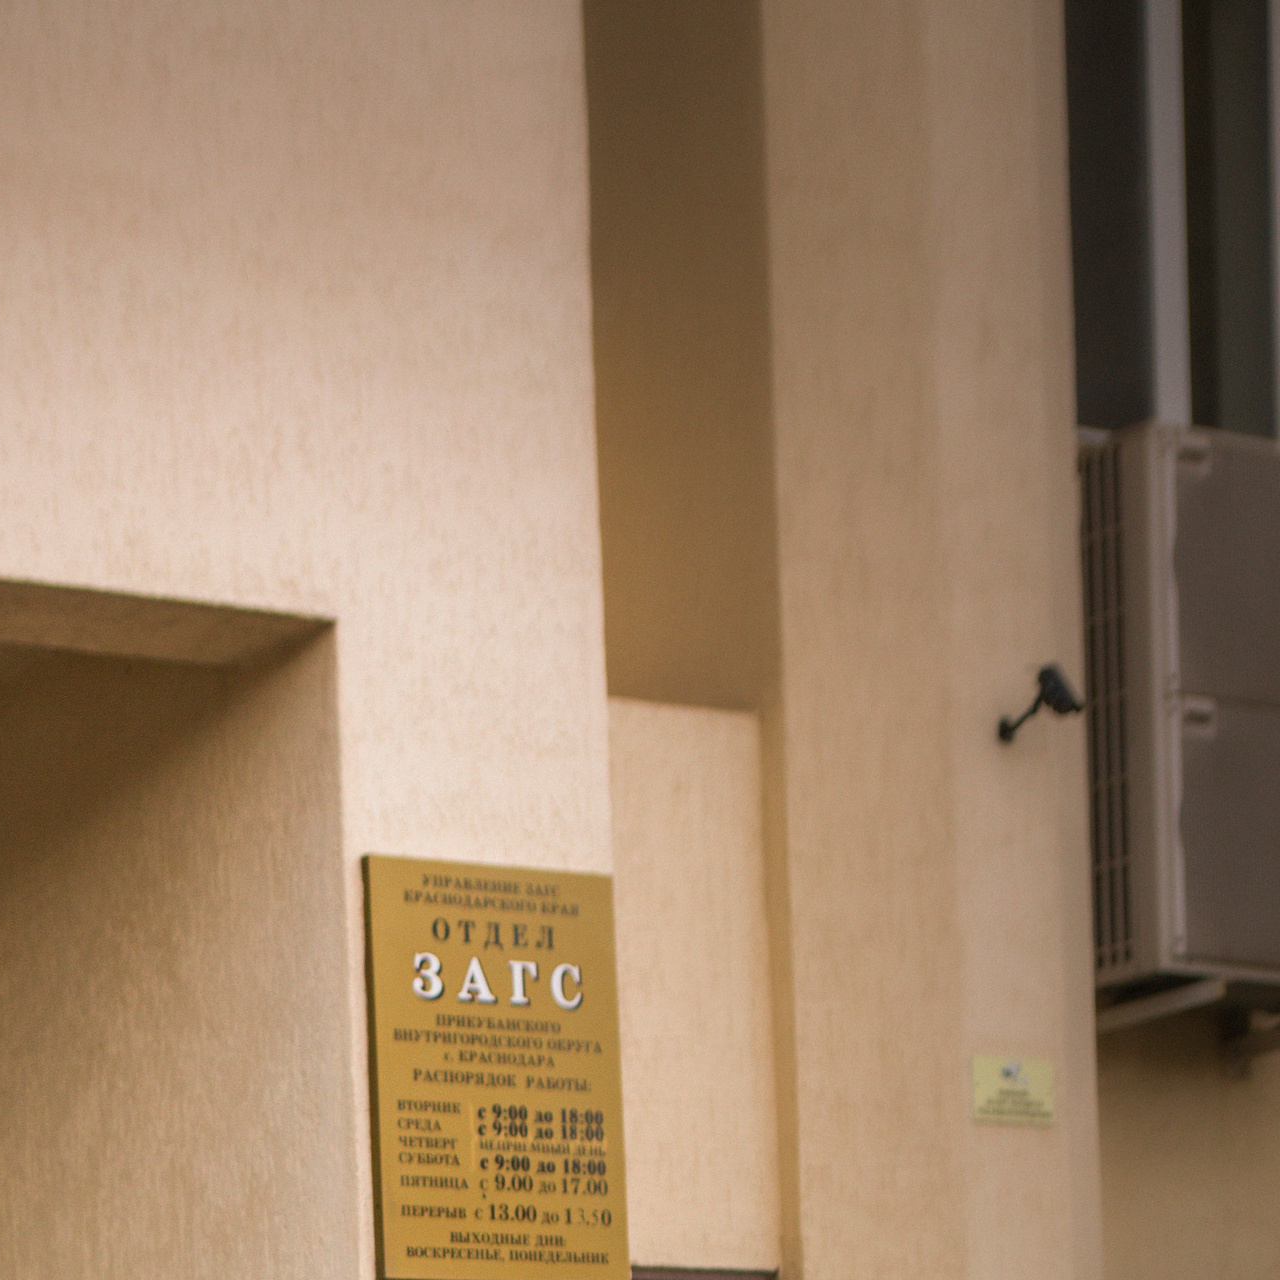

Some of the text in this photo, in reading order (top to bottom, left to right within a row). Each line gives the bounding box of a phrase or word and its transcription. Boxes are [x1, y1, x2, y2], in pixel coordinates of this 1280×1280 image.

[423, 873, 560, 898] УПРАВЛЕНИЕ ЗАГС
[404, 888, 579, 916] КРАСНОДАРСКОГО КРАЯ
[432, 917, 554, 950] ОТДЕЛ
[412, 952, 583, 1010] ЗАГС
[436, 1014, 561, 1034] ПРИКУБАНСКОГО
[393, 1028, 602, 1054] ВНУТРИГОРОДСКОГО ОКРУГА
[459, 1050, 555, 1068] КРАСНОДАРА
[413, 1068, 516, 1087] РАСПОРЯДОК
[397, 1100, 604, 1125] ВТОРНИК с 9:00 до 18:00
[397, 1117, 604, 1142] СРЕДА с 9:00 до 18:00
[399, 1136, 458, 1150] ЧЕТВЕРГ
[398, 1152, 606, 1176] СУББОТА с 9:00 до 18:00
[400, 1175, 468, 1190] ПЯТНИЦА
[494, 1173, 533, 1192] 9.00
[539, 1181, 556, 1194] до
[562, 1177, 608, 1196] 17.00
[401, 1205, 466, 1219] ПЕРЕРЫВ
[489, 1203, 537, 1222] 13.00
[541, 1210, 560, 1224] до
[450, 1231, 530, 1246] ВЫХОДНЫЕ
[406, 1246, 609, 1264] ВОСКРЕСЕНЬЕ, ПОНЕДЕЛЬНИК
